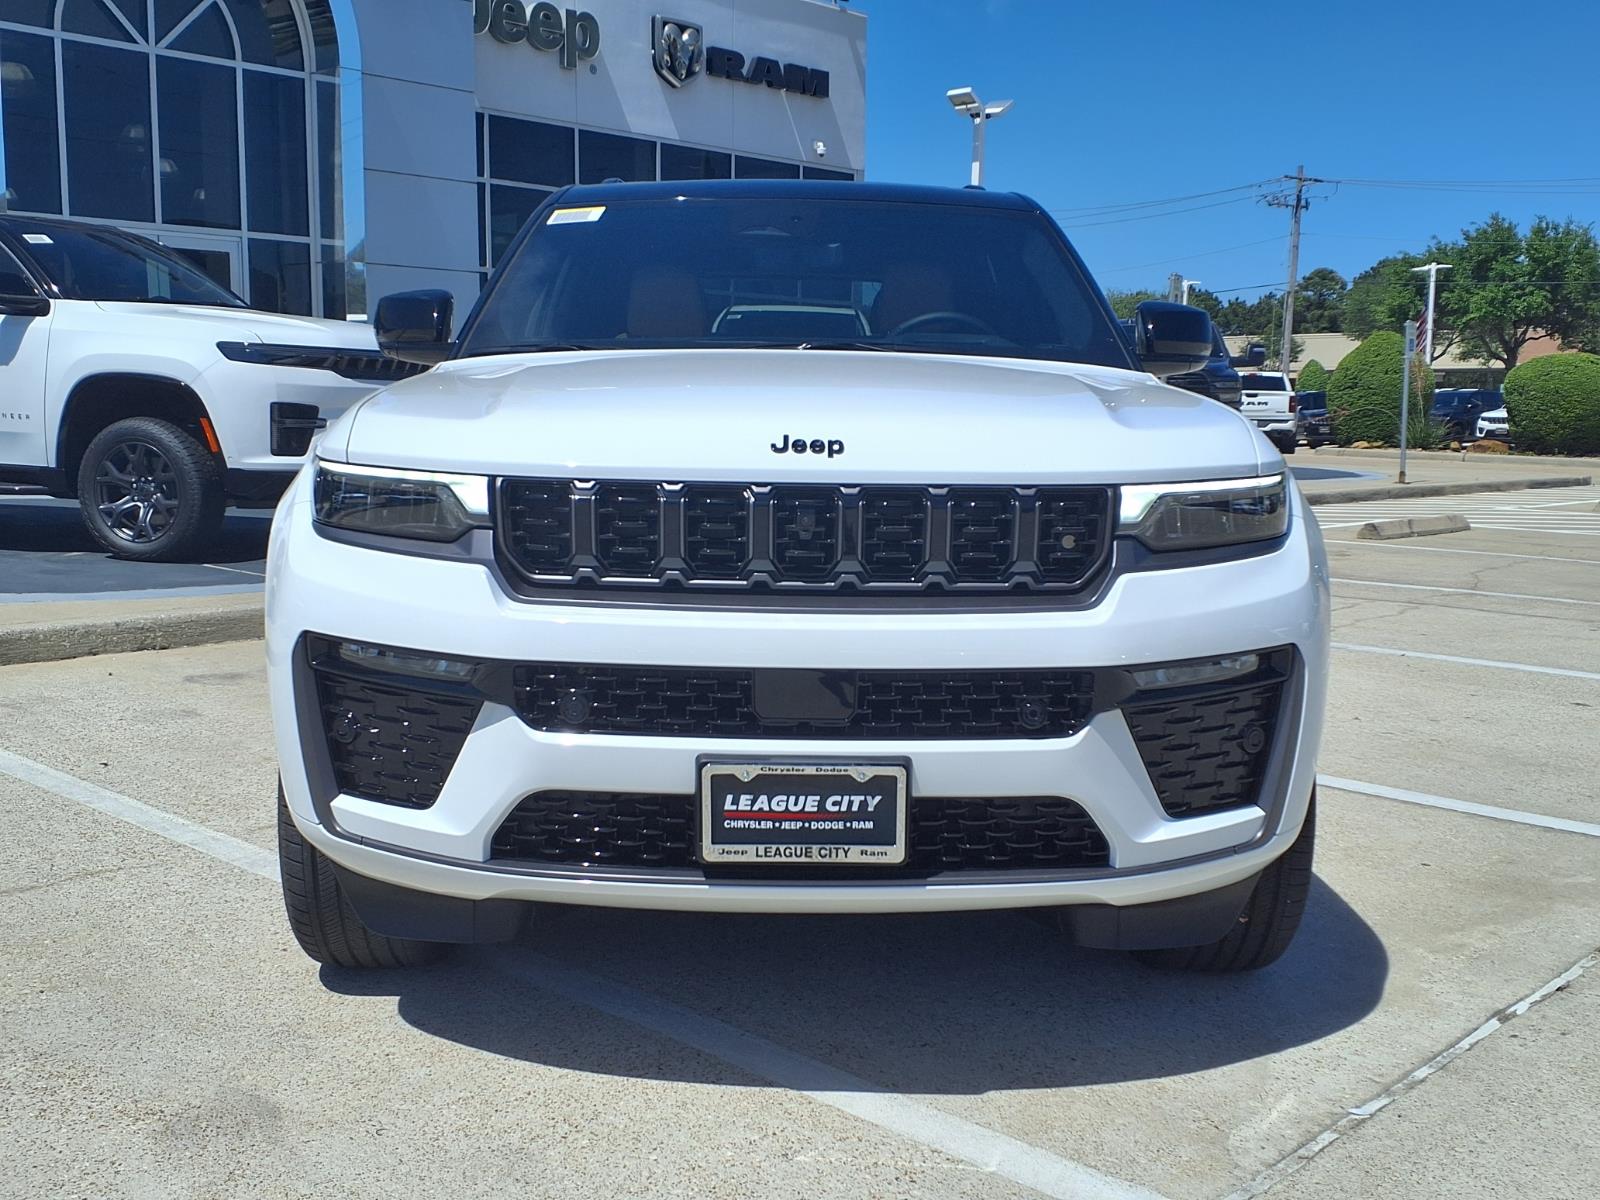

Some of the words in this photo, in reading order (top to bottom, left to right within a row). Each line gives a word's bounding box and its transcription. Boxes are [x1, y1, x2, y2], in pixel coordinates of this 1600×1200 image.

[706, 46, 829, 98] RAM
[770, 434, 845, 459] Jeep
[723, 794, 820, 812] LEAGUE
[825, 794, 883, 812] CITY
[723, 820, 773, 829] CHRYSLER
[781, 820, 803, 830] JEEP
[811, 820, 845, 830] DODGE
[852, 820, 874, 830] RAM
[718, 848, 748, 856] Jeep
[755, 846, 813, 858] LEAGUE
[818, 847, 851, 859] CITY
[860, 849, 888, 857] Ram
